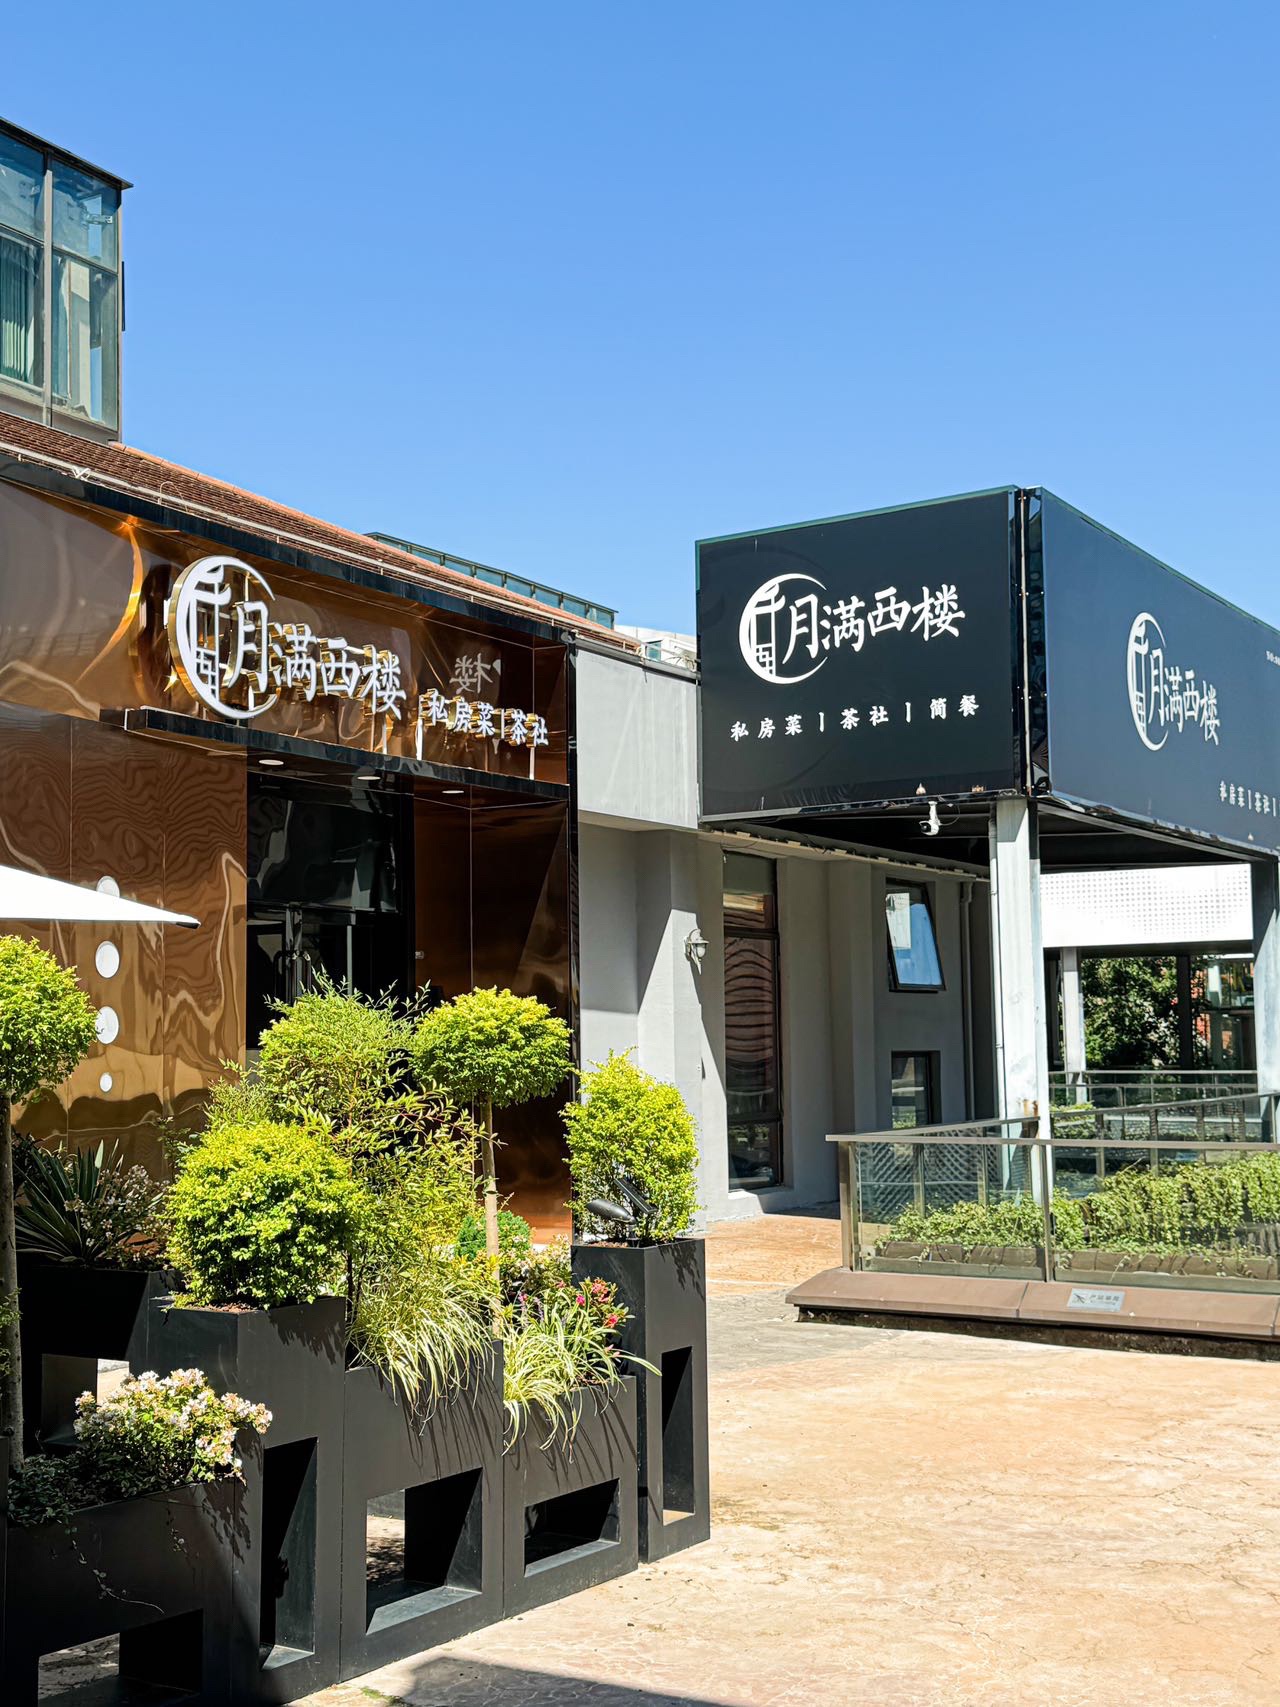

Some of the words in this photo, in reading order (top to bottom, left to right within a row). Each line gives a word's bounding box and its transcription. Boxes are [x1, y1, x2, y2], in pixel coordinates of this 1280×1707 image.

[228, 601, 407, 720] 月满西楼
[782, 584, 966, 665] 月满西楼
[1148, 647, 1221, 746] 月满西楼
